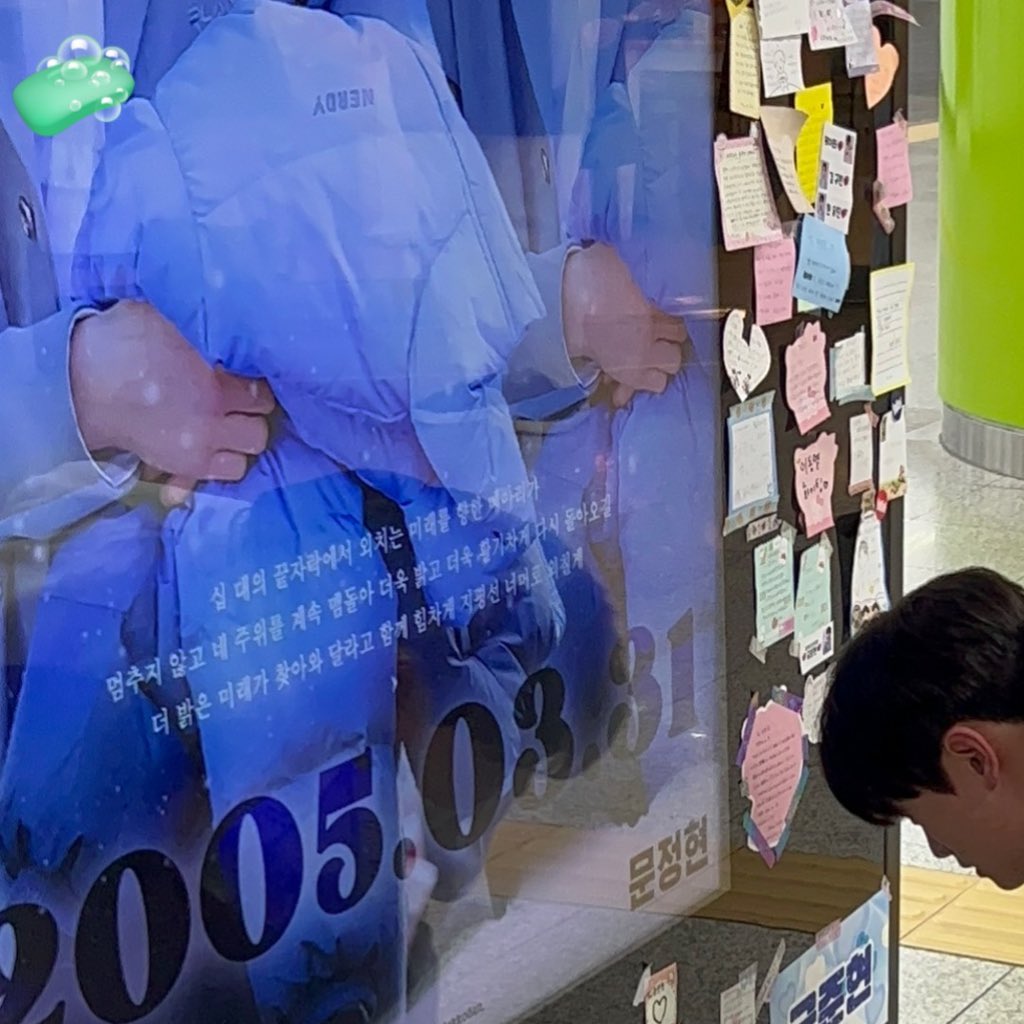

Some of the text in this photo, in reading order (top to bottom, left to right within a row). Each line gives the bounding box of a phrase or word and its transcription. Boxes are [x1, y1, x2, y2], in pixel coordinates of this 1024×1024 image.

[312, 87, 375, 117] NERDY
[105, 492, 613, 703] 멈추지 않고 네 주위를 계속 맴돌아 더욱 밝고 더욱 활기차게 다시 돌아오길
[210, 581, 227, 612] 십
[233, 568, 267, 602] 대의
[273, 538, 353, 590] 끝자락에서
[359, 526, 405, 558] 외치는
[408, 507, 451, 541] 미래를
[456, 495, 484, 526] 향한
[151, 706, 170, 735] 더
[175, 691, 213, 730] 밝은
[218, 668, 269, 709] 미래가
[275, 647, 323, 691] 찾아와
[328, 631, 375, 668] 달라고
[379, 614, 409, 648] 함께
[413, 596, 456, 634] 힘차게
[460, 579, 501, 613] 지평선
[504, 563, 544, 597] 너머로
[628, 814, 709, 912] 문정현
